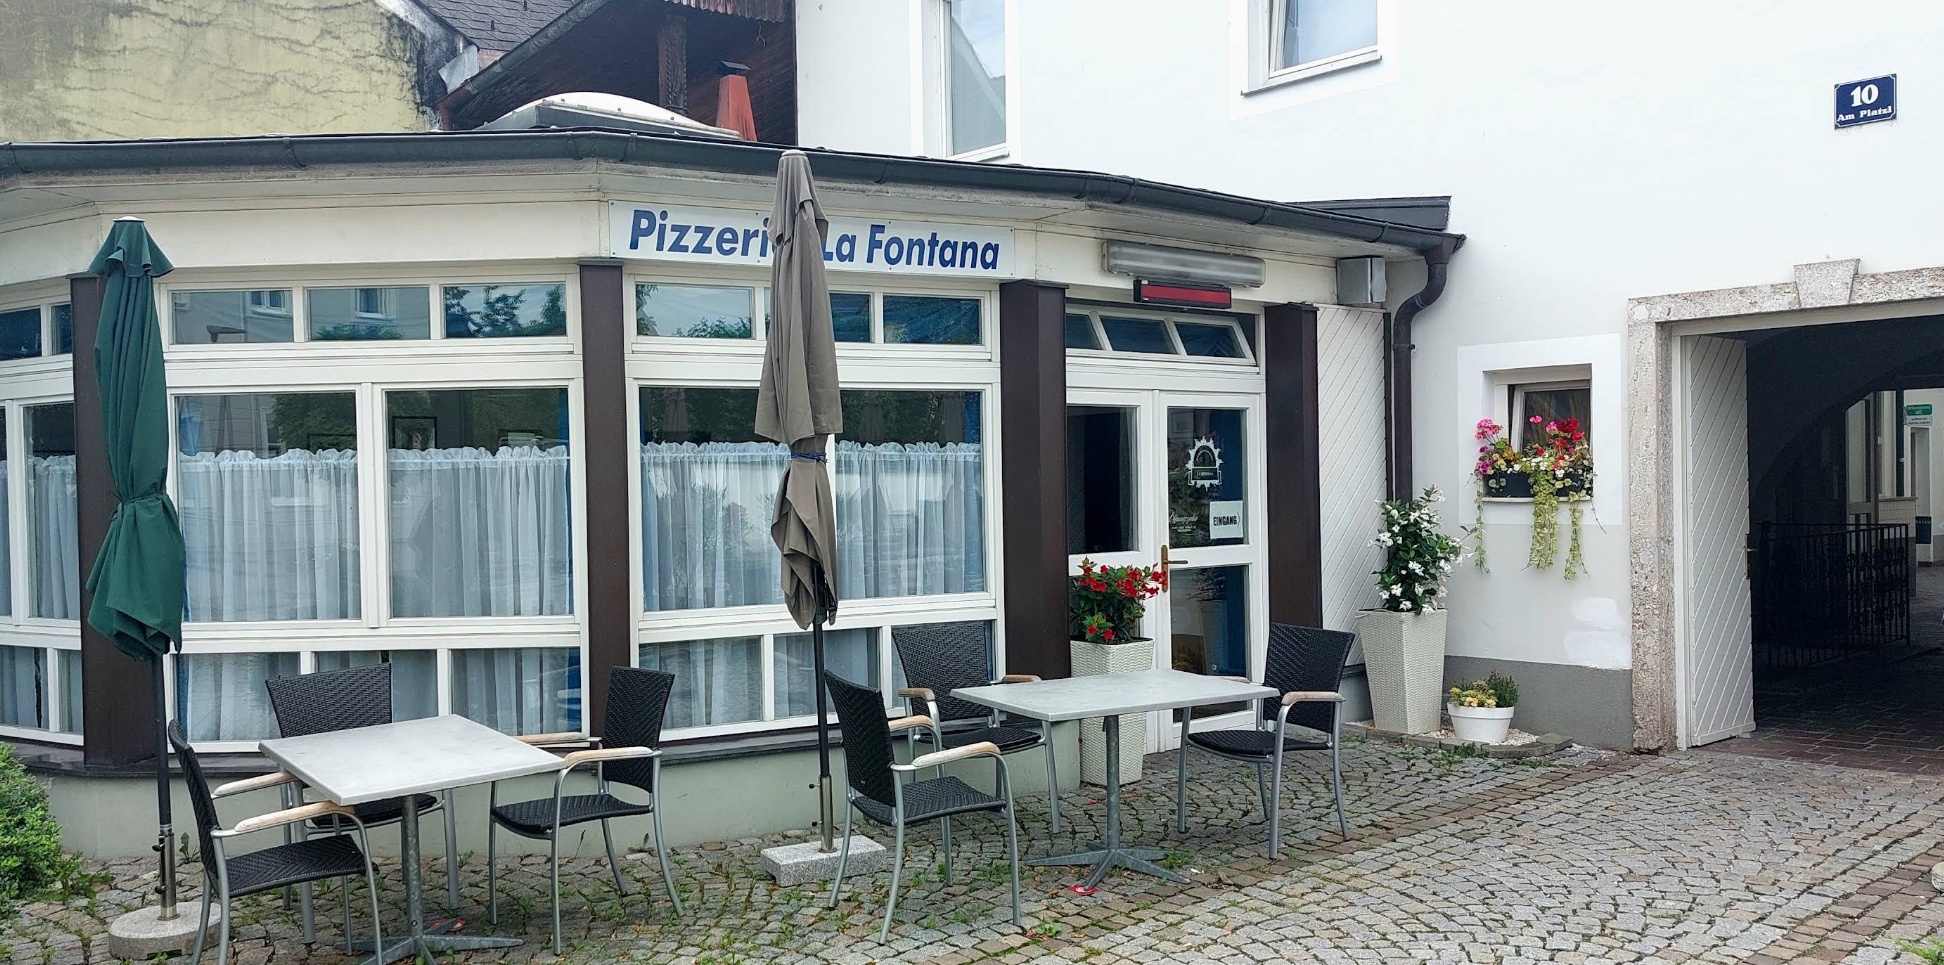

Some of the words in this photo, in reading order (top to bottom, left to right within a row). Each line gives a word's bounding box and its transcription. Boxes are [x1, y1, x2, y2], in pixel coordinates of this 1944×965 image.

[1850, 84, 1879, 107] 10
[1837, 114, 1855, 122] Am
[1859, 106, 1892, 118] Platzl
[629, 209, 776, 258] Pizzeri
[867, 224, 1000, 271] Fontana
[1213, 516, 1238, 526] EINGANG
